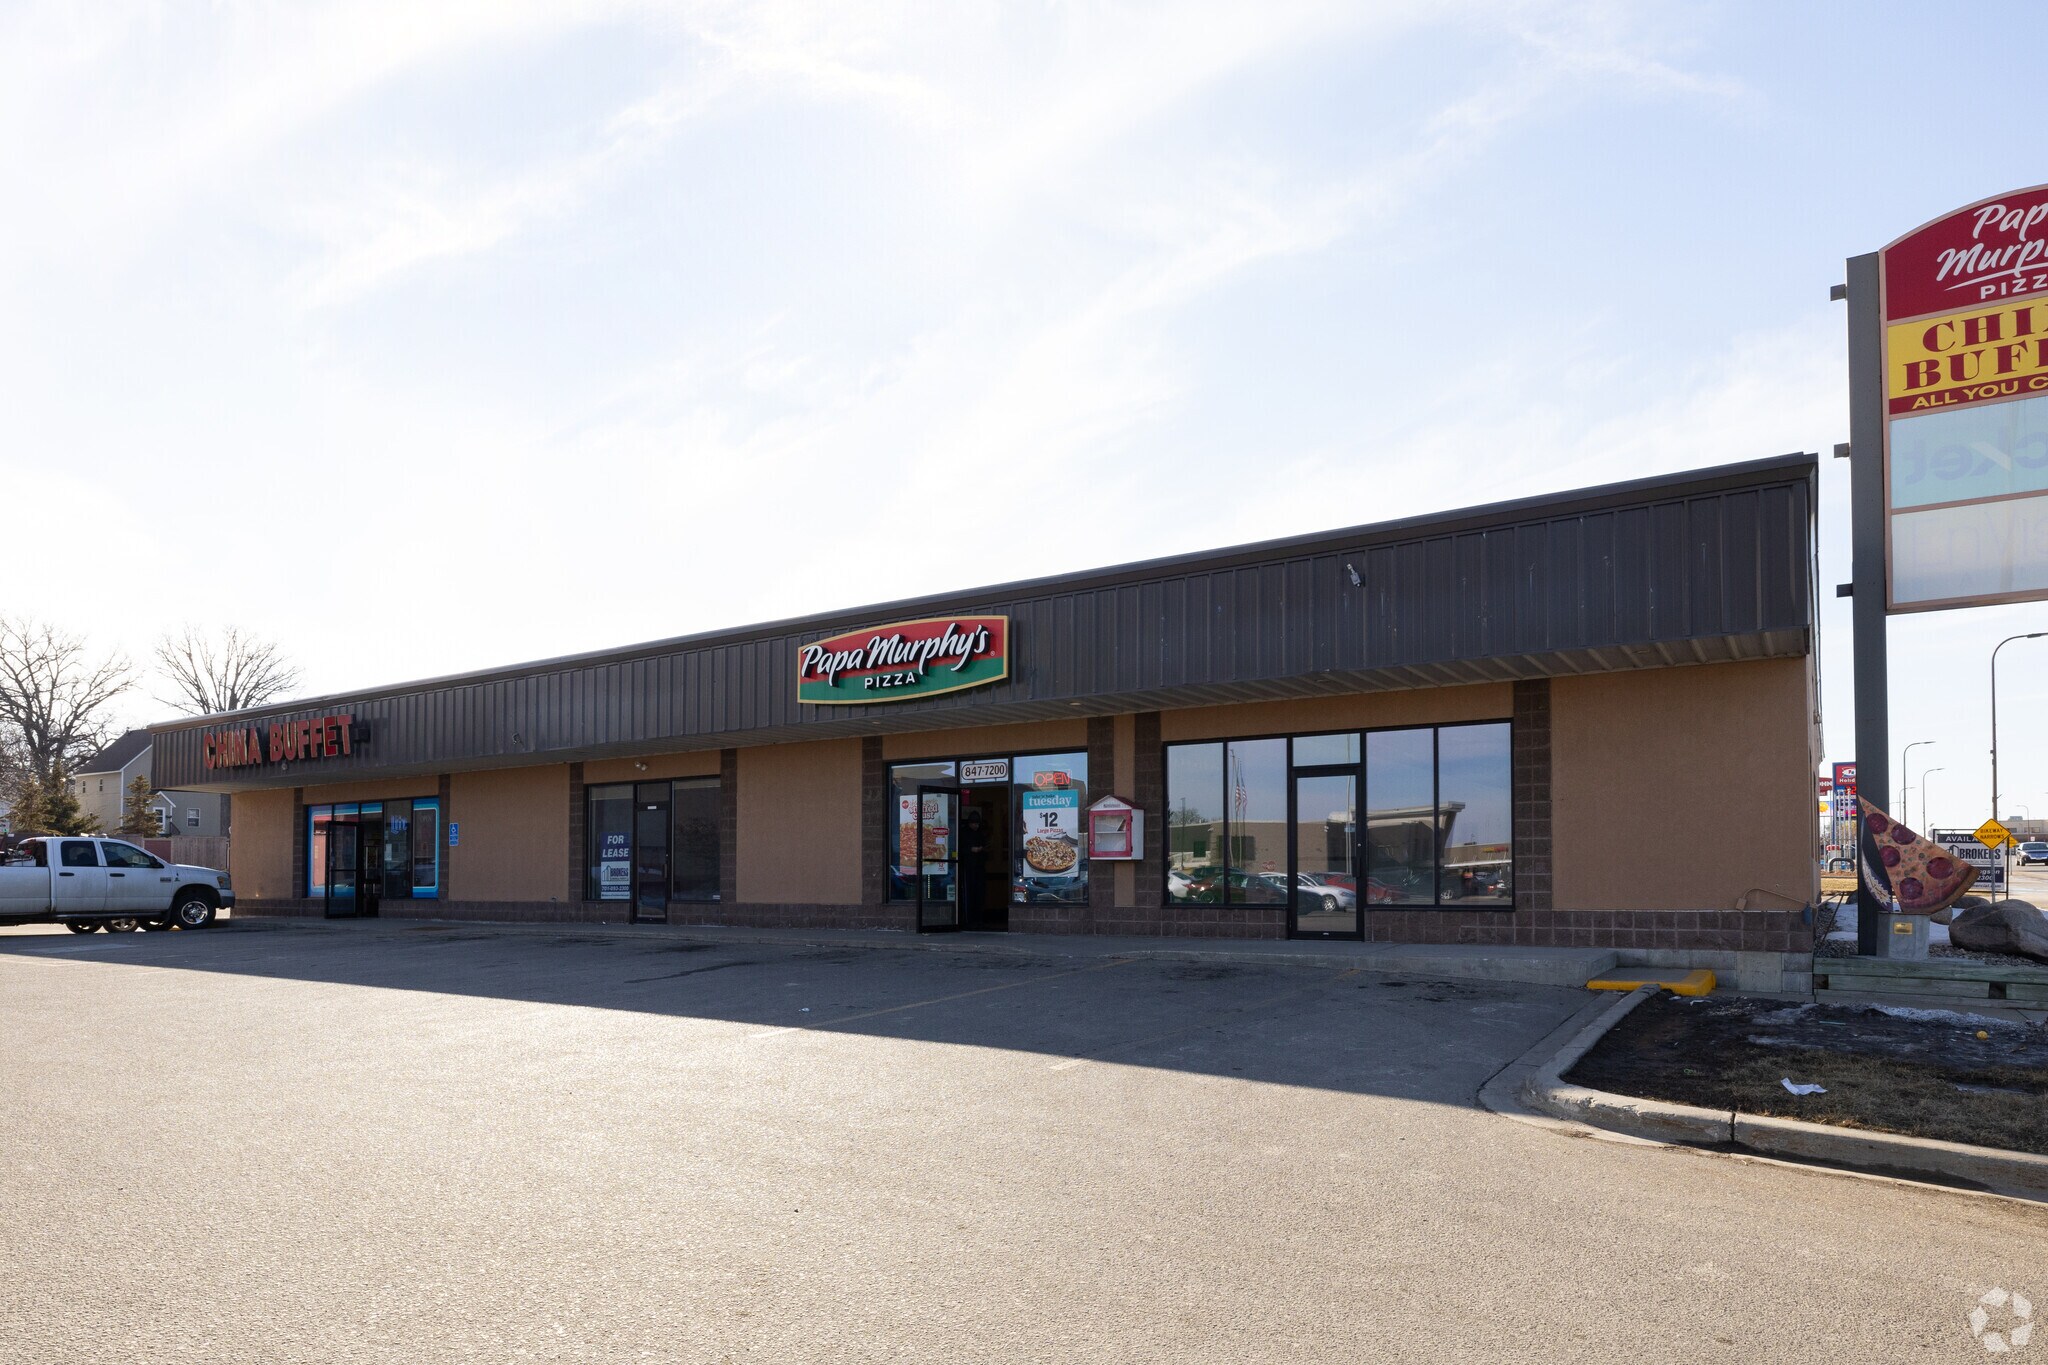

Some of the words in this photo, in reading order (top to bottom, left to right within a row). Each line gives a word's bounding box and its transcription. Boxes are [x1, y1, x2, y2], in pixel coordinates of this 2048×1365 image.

[1936, 238, 2048, 281] Murp
[1980, 274, 2048, 299] PIZZ
[1922, 304, 2048, 352] CHI
[1911, 392, 1958, 409] ALL
[1962, 381, 2019, 400] YOU
[801, 645, 864, 687] Papa
[866, 622, 989, 675] Murphy's
[864, 671, 916, 689] PIZZA
[204, 727, 262, 769] CHINA
[269, 714, 353, 762] BUFFET
[1034, 770, 1071, 787] OPEN
[1029, 795, 1073, 807] tuesday
[912, 812, 936, 821] cust
[1039, 812, 1058, 828] $12
[607, 835, 625, 845] FOR
[602, 848, 630, 858] LEASE
